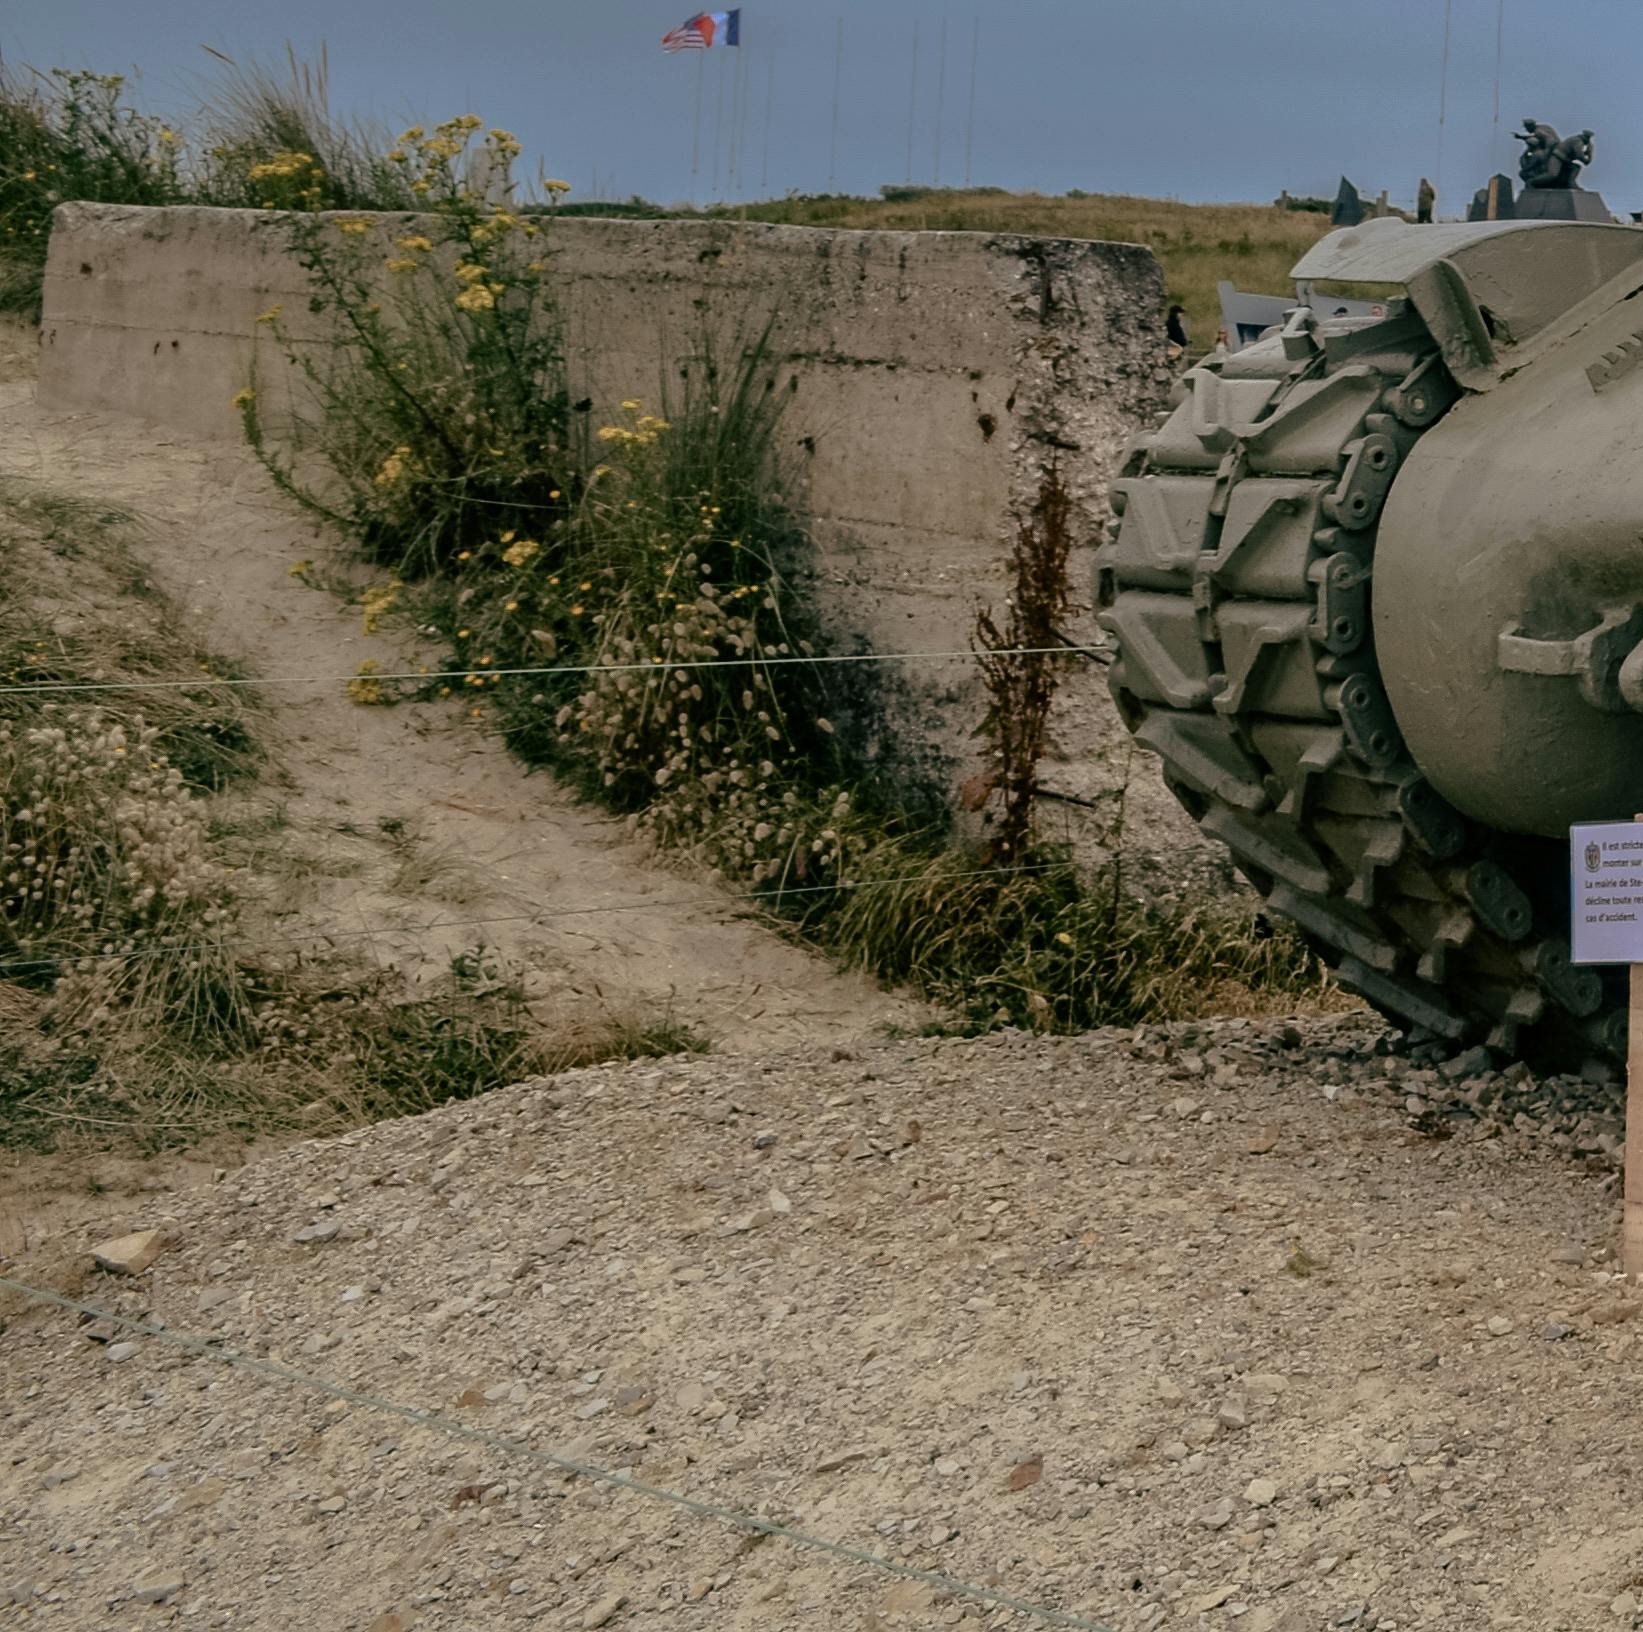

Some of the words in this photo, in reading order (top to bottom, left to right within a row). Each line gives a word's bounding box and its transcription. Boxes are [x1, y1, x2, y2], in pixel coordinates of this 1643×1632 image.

[1602, 859, 1629, 867] monter
[1585, 880, 1593, 889] La
[1595, 879, 1617, 888] mairie
[1619, 878, 1628, 887] de
[1585, 896, 1610, 906] décline
[1612, 895, 1631, 905] toute
[1586, 914, 1597, 923] cas
